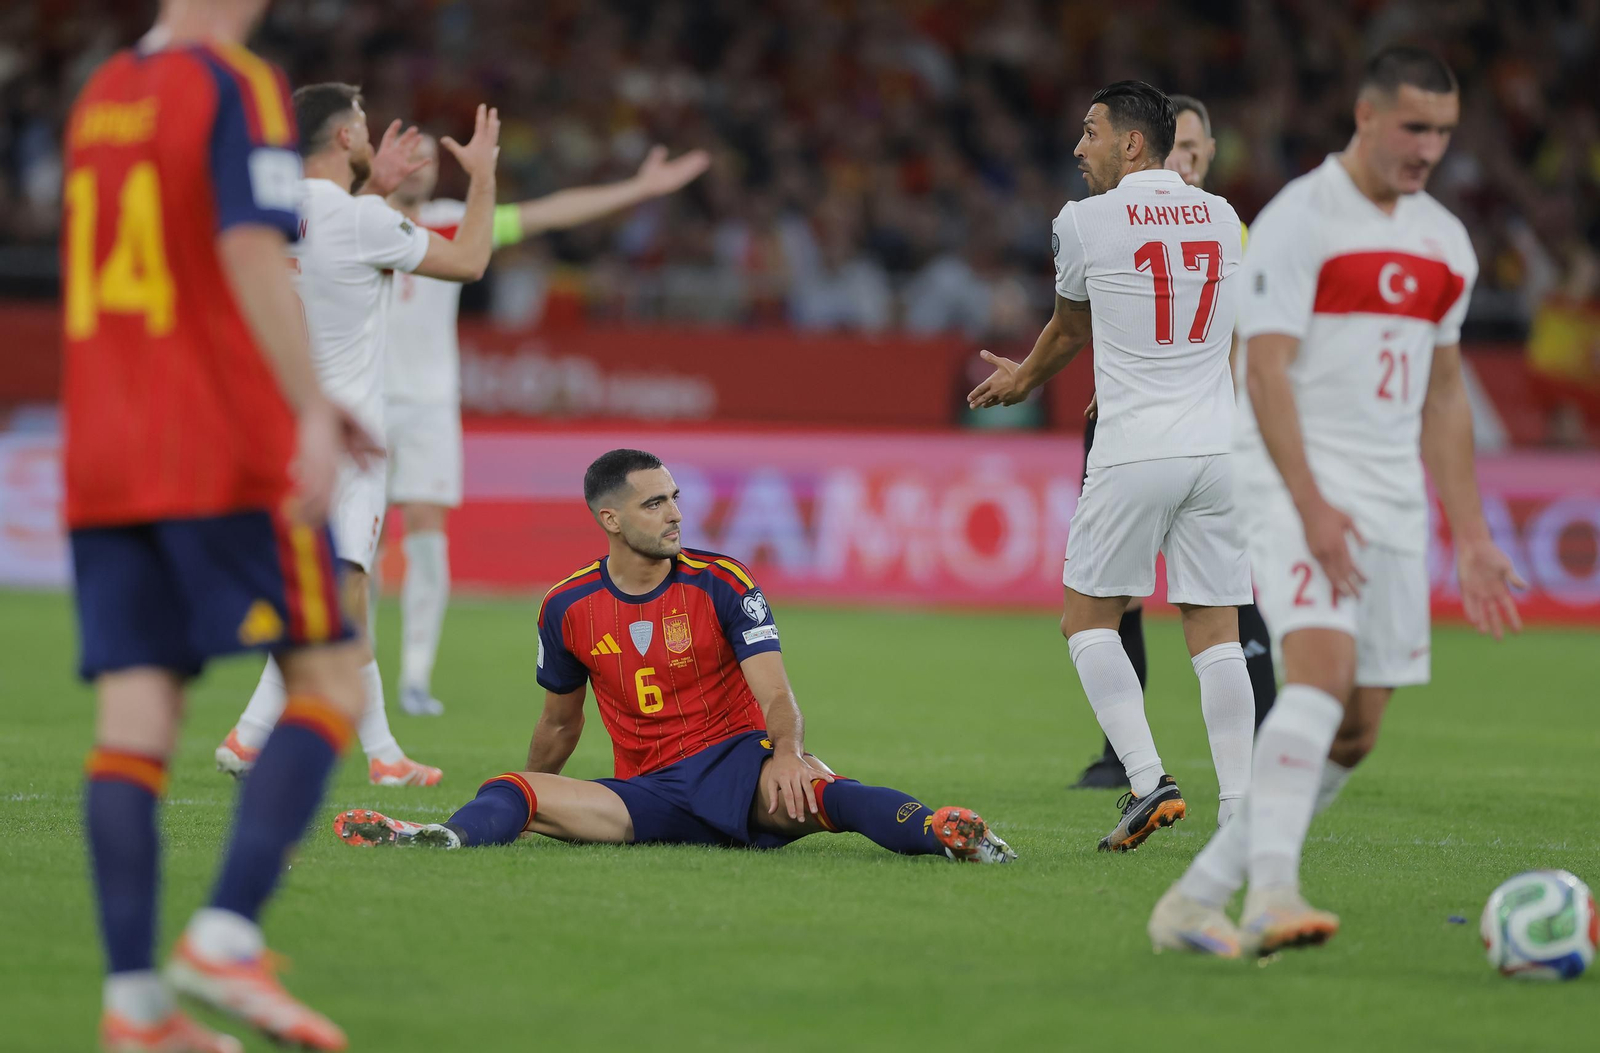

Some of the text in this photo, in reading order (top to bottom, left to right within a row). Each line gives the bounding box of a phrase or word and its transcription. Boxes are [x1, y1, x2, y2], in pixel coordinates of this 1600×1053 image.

[1126, 201, 1212, 226] KAHVECİ
[64, 161, 176, 341] 14
[1134, 240, 1224, 345] 17
[1375, 349, 1410, 402] 21
[634, 667, 664, 714] 6
